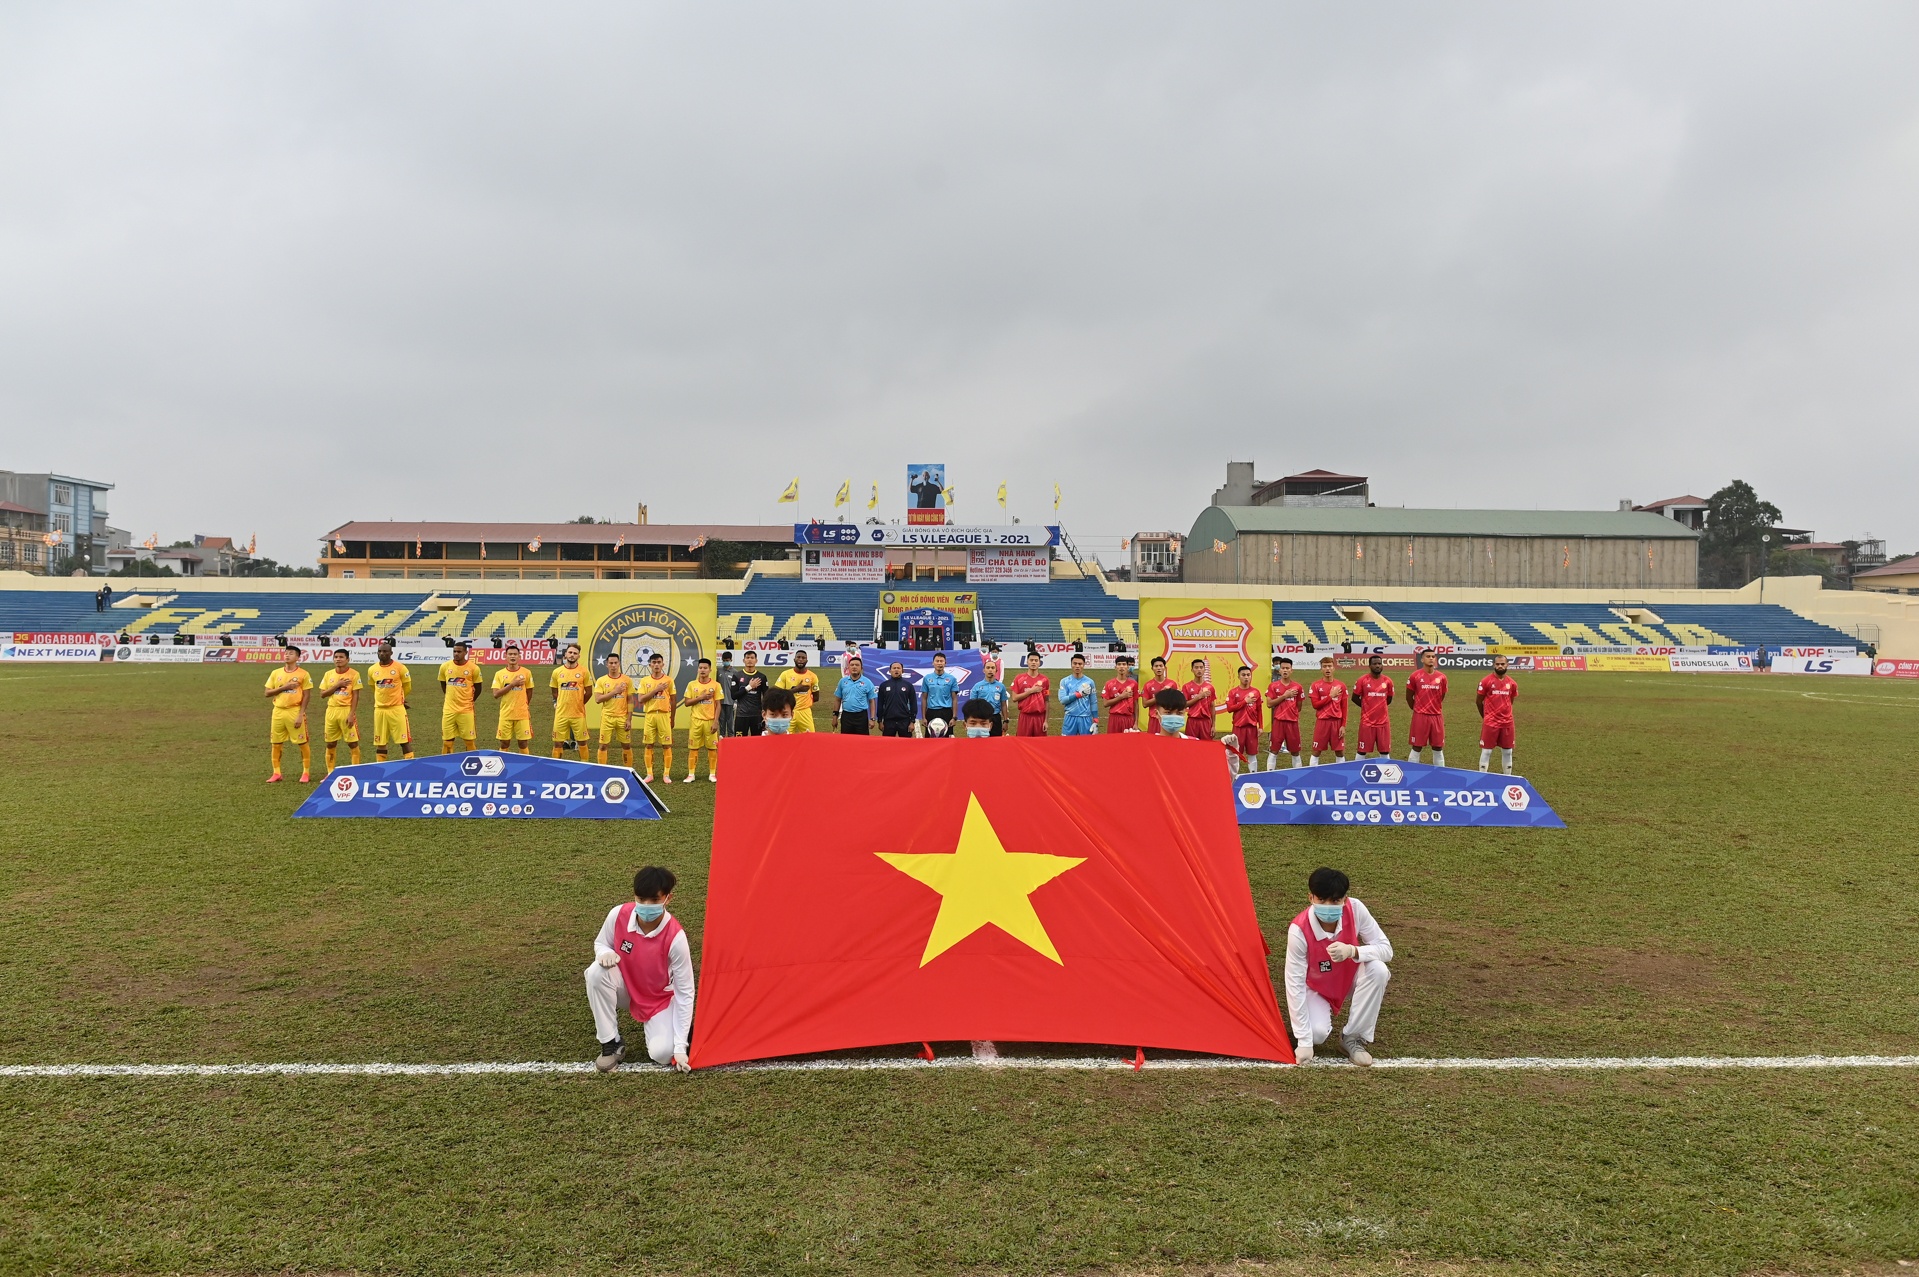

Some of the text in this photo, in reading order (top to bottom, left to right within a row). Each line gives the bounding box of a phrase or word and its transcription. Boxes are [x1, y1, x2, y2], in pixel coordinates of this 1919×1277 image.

[903, 534, 917, 544] LS
[921, 534, 982, 544] V.LEAGUE
[985, 534, 991, 544] 1
[1000, 535, 1031, 544] 2021
[822, 550, 884, 558] NHÀ HÀNG KING BBQ
[999, 549, 1036, 557] NHÀ HÀNG
[988, 557, 1046, 566] CHẢ CÁ ĐẾ ĐÔ
[901, 596, 910, 604] HỘI
[937, 595, 950, 603] VIÊN
[958, 606, 969, 614] HÓA
[599, 611, 694, 647] THANH HÓA FC
[1174, 628, 1237, 638] NAMDINH
[31, 634, 96, 644] JOGARBOLA
[520, 639, 548, 649] VPF
[1047, 644, 1075, 652] VPF
[17, 648, 96, 656] NEXT MEDIA
[1427, 646, 1454, 654] VPF
[1650, 647, 1676, 655] VPF
[1797, 648, 1824, 657] VPF
[246, 652, 272, 660] ĐÔNG
[312, 650, 334, 660] VP
[486, 650, 554, 660] JORBOLA
[763, 654, 788, 666] LS
[1542, 659, 1578, 668] ĐÔNG Á
[1804, 661, 1833, 672] LS
[1898, 662, 1912, 670] CÔNG
[465, 762, 478, 770] LS
[362, 782, 390, 799] LS
[396, 782, 507, 799] V.LEAGUE
[512, 782, 524, 799] 1
[541, 783, 596, 799] 2021
[1271, 789, 1296, 806] LS
[1301, 789, 1411, 806] V.LEAGUE
[1415, 789, 1428, 806] 1
[1443, 790, 1498, 806] 2021
